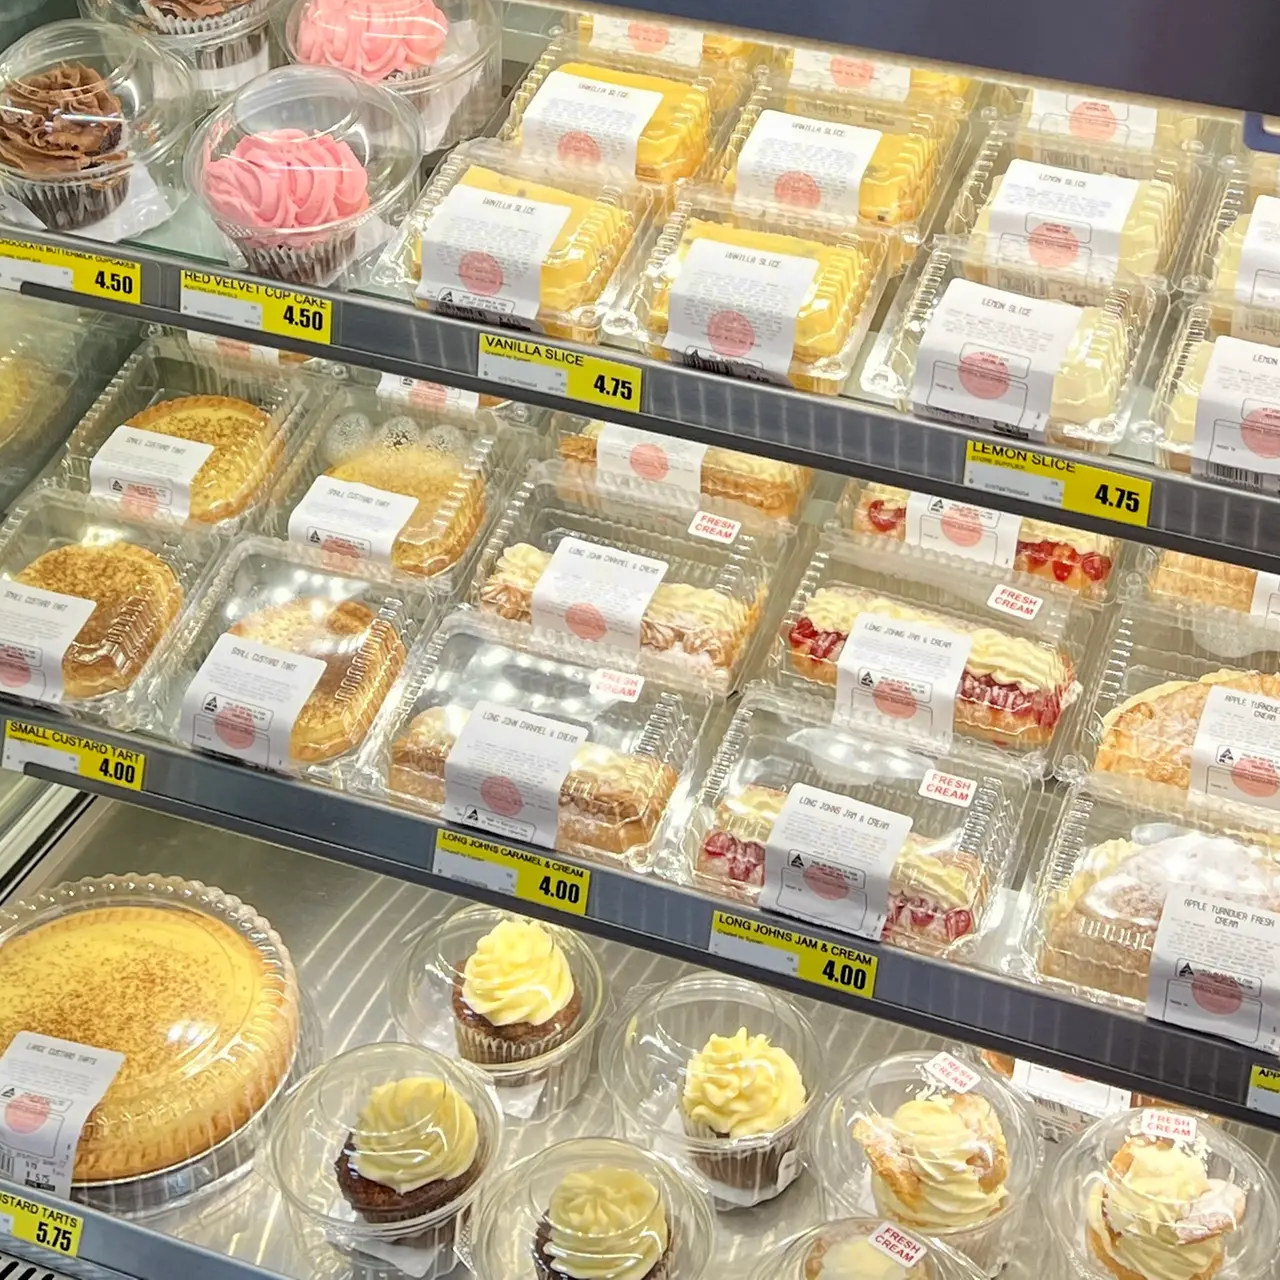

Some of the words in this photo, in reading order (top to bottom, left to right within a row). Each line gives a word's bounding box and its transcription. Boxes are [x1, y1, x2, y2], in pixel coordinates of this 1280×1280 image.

[45, 245, 94, 261] BUTTERMILK
[95, 255, 137, 270] CUPCAKES
[95, 270, 133, 295] 4.50
[184, 271, 211, 284] RED
[214, 275, 261, 295] VELVET
[264, 286, 291, 301] CUP
[294, 294, 327, 309] CAKE
[283, 305, 323, 331] 4.50
[484, 335, 542, 357] VANILLA
[544, 348, 585, 367] SLICE
[1252, 354, 1278, 365] LEMON
[594, 374, 632, 401] 4.75
[972, 441, 1027, 462] LEMON
[1031, 453, 1076, 473] SLICE
[1095, 483, 1140, 513] 4.75
[694, 523, 732, 538] CREAM
[700, 514, 735, 529] FRESH
[994, 596, 1034, 615] CREAM
[1000, 588, 1037, 606] FRESH
[10, 721, 49, 740] SMALL
[52, 731, 108, 755] CUSTARD
[111, 746, 141, 763] TART
[99, 758, 136, 783] 4.00
[931, 773, 971, 790] FRESH
[799, 796, 818, 809] LONG
[926, 783, 969, 801] CREAM
[442, 831, 468, 845] LONG
[469, 839, 499, 854] JOHNS
[500, 847, 542, 866] CARAMEL
[544, 860, 551, 869] &
[552, 862, 584, 878] CREAM
[539, 875, 580, 904] 4.00
[719, 914, 751, 931] LONG
[753, 923, 792, 942] JOHNS
[795, 935, 818, 950] JAM
[820, 943, 828, 953] &
[831, 945, 872, 966] CREAM
[822, 960, 867, 990] 4.00
[41, 1207, 77, 1228] TARTS
[36, 1221, 72, 1252] 5.75
[874, 1234, 914, 1262] CREAM
[883, 1227, 921, 1254] FRESH
